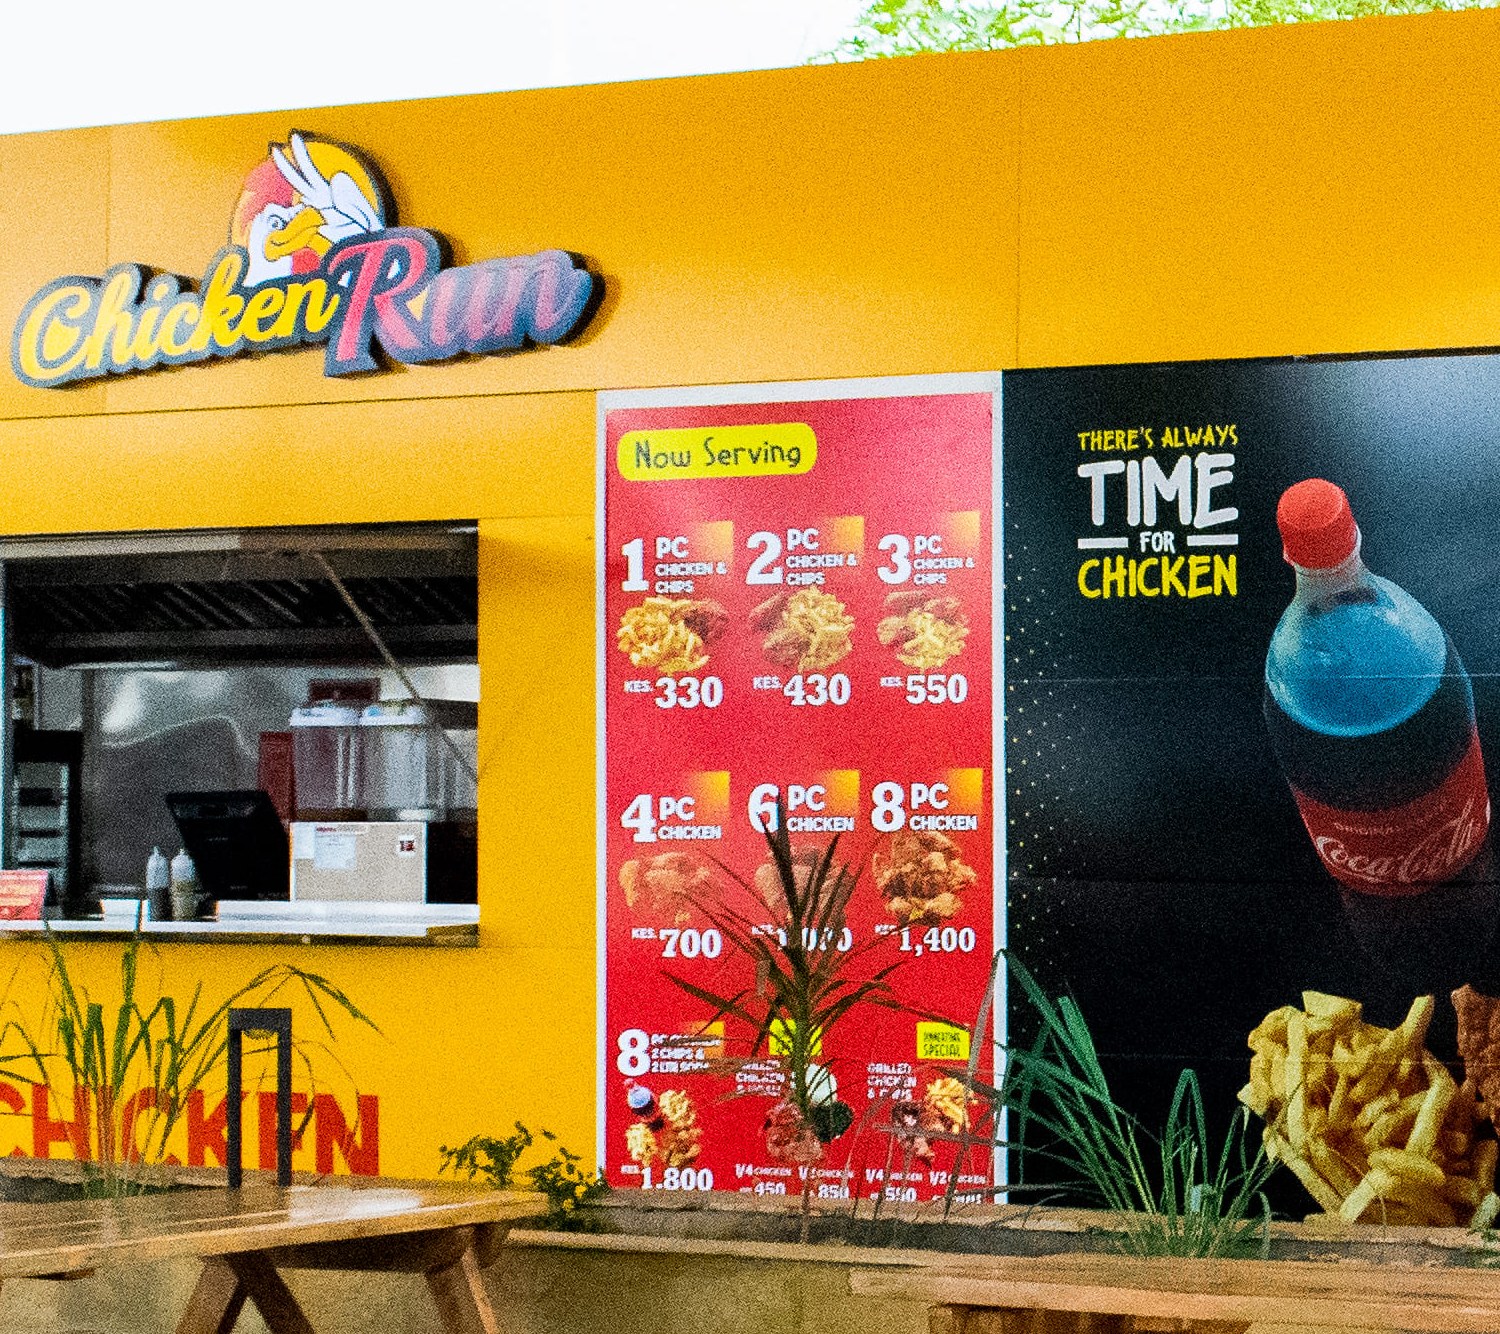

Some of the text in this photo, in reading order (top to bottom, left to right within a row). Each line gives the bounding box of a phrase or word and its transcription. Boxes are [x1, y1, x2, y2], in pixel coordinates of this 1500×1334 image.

[15, 234, 585, 382] Chicken Run
[634, 436, 801, 469] Now Serving
[1077, 424, 1239, 452] THERE'S ALWAYS
[1077, 451, 1239, 529] TIME
[745, 528, 820, 586] 2 PC
[1139, 530, 1176, 555] FOR
[621, 536, 690, 592] 1 PC
[655, 562, 714, 577] CHICKEN
[785, 554, 844, 569] CHICKEN
[876, 533, 943, 585] 3 PC
[913, 557, 964, 570] CHICKEN
[654, 579, 695, 594] CHIPS
[786, 571, 826, 586] CHIPS
[1077, 554, 1239, 599] CHICKEN
[655, 676, 724, 709] 330
[783, 673, 851, 706] 430
[905, 673, 969, 705] 550
[620, 793, 697, 843] 4 PC
[748, 782, 827, 834] 6 PC
[871, 781, 950, 833] 8 PC
[909, 814, 978, 832] CHICKEN
[657, 825, 722, 840] CHICKEN
[787, 816, 856, 833] CHICKEN
[659, 928, 723, 959] 700
[900, 926, 976, 957] 1,400
[617, 1028, 651, 1076] 8
[923, 1043, 961, 1057] SPECIAL
